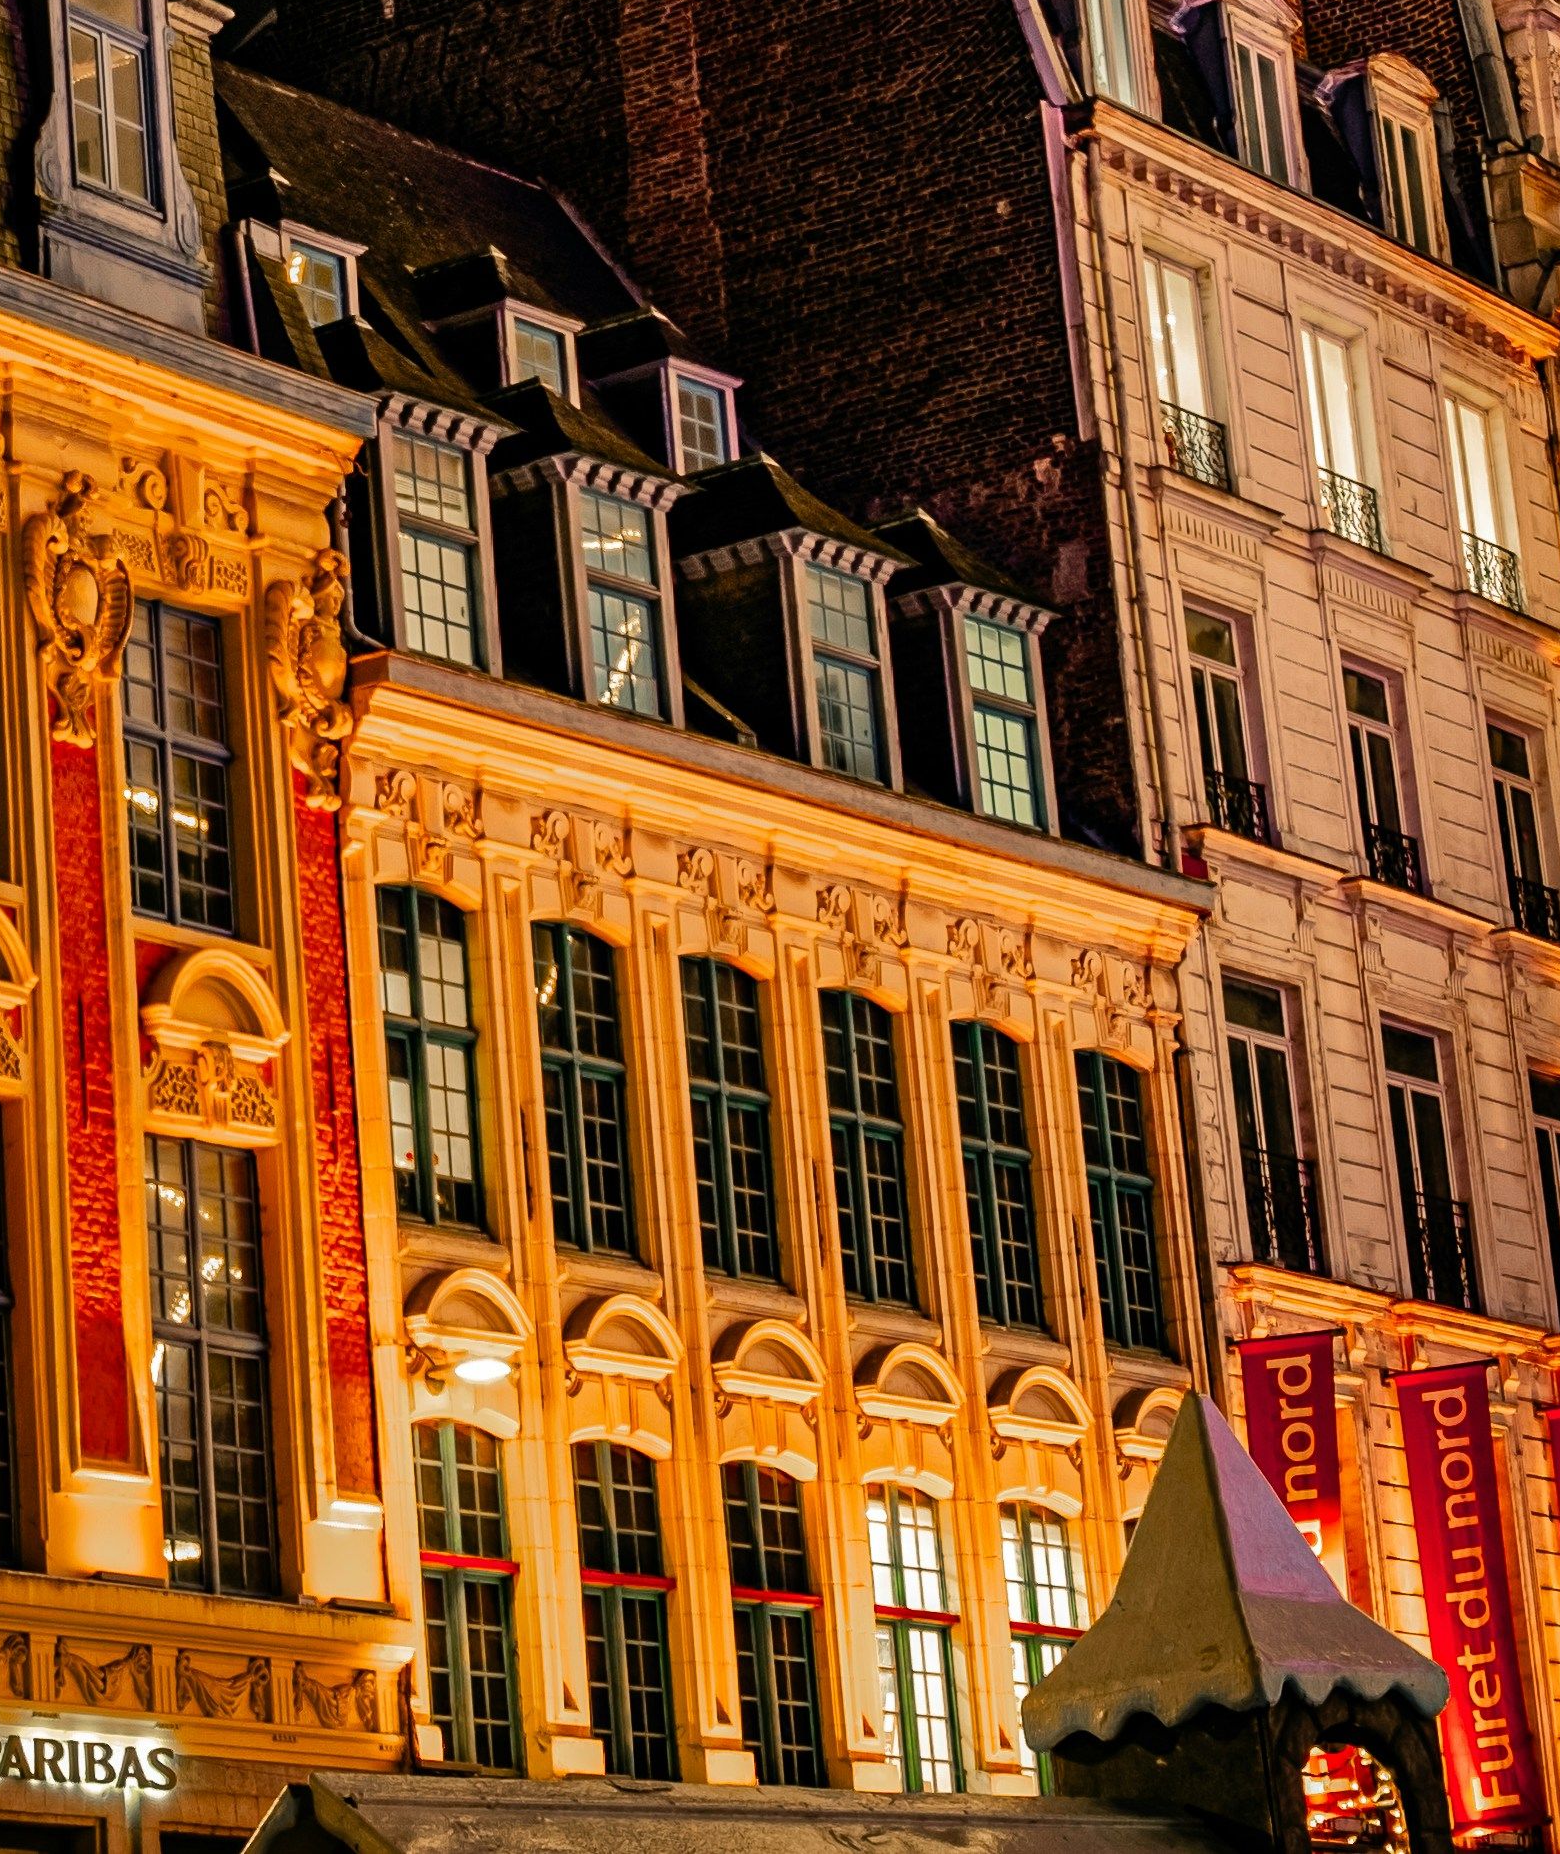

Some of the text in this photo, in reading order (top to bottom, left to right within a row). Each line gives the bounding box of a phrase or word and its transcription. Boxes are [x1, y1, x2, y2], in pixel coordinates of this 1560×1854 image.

[1266, 1353, 1319, 1503] nord
[1421, 1385, 1521, 1814] Furet du nord
